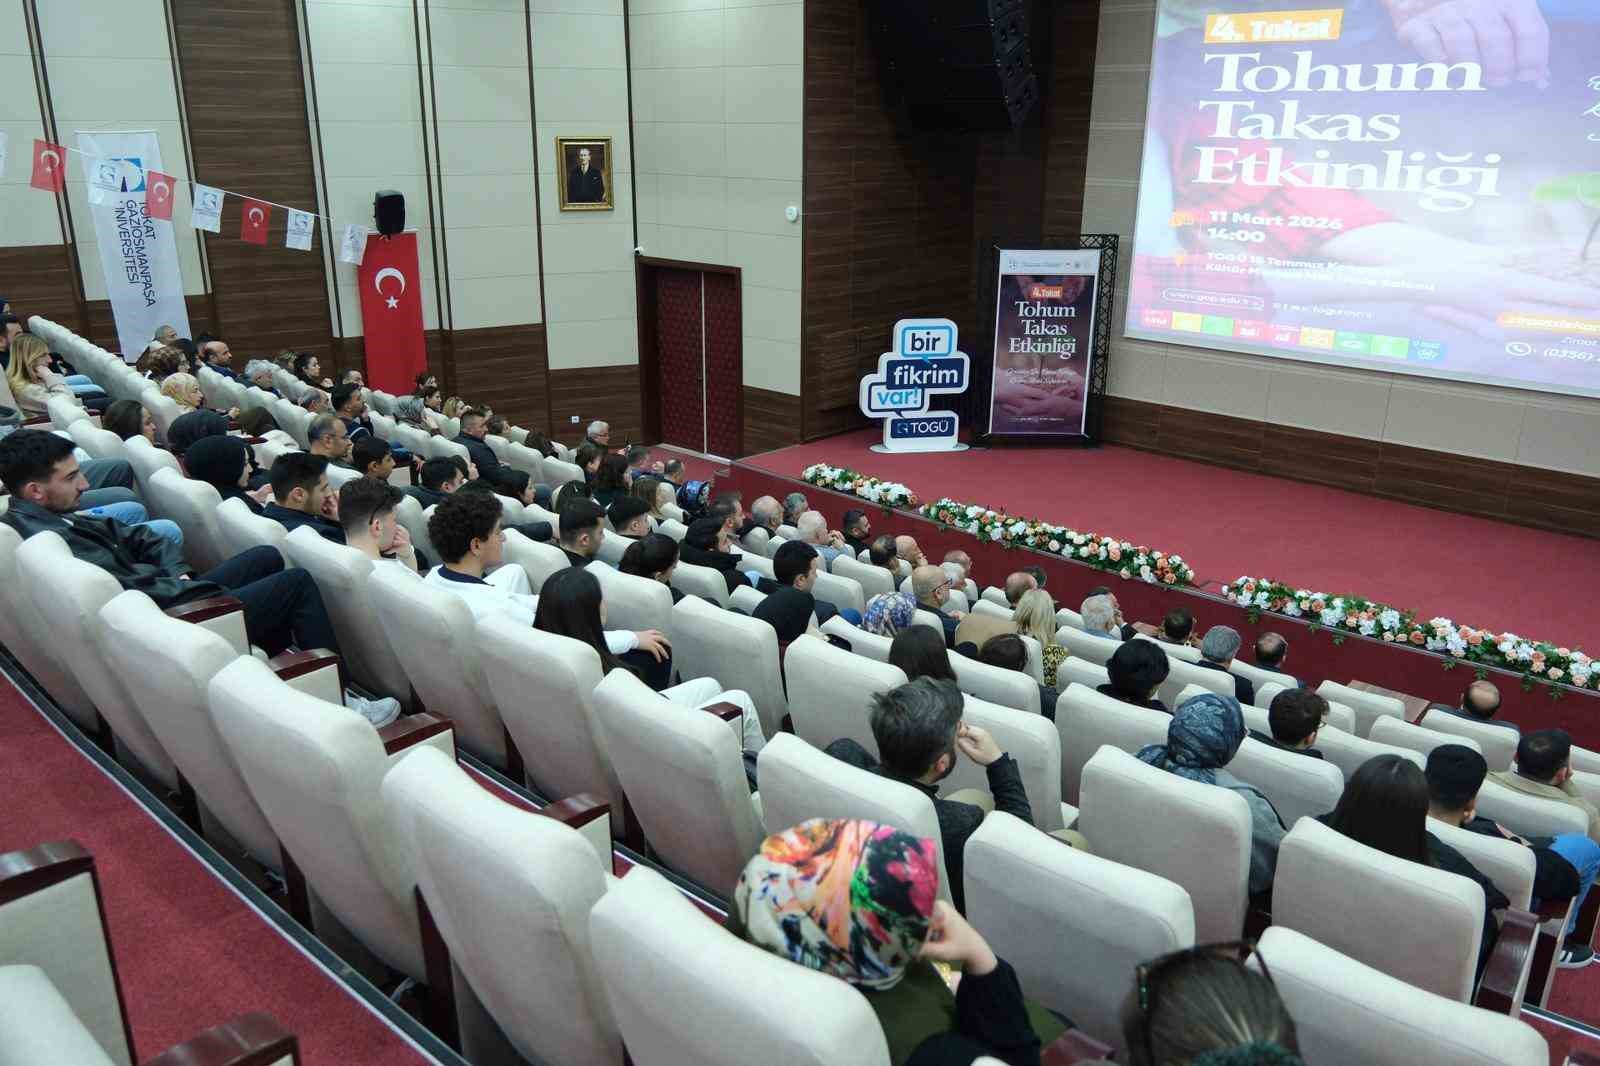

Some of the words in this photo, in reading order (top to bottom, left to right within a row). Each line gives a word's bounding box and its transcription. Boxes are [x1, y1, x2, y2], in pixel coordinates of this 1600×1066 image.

[1203, 49, 1488, 94] Tohum
[1197, 99, 1402, 142] Takas
[1191, 145, 1503, 212] Etkinliği
[1208, 210, 1228, 223] 11
[1231, 211, 1283, 227] Mart
[1287, 215, 1344, 230] 2026
[1207, 227, 1266, 243] 14:00
[1014, 301, 1076, 318] Tohum
[1021, 319, 1068, 336] Takas
[911, 331, 941, 352] bir
[1008, 337, 1077, 360] Etkinliği
[894, 363, 958, 384] fikrim
[876, 388, 919, 406] var!
